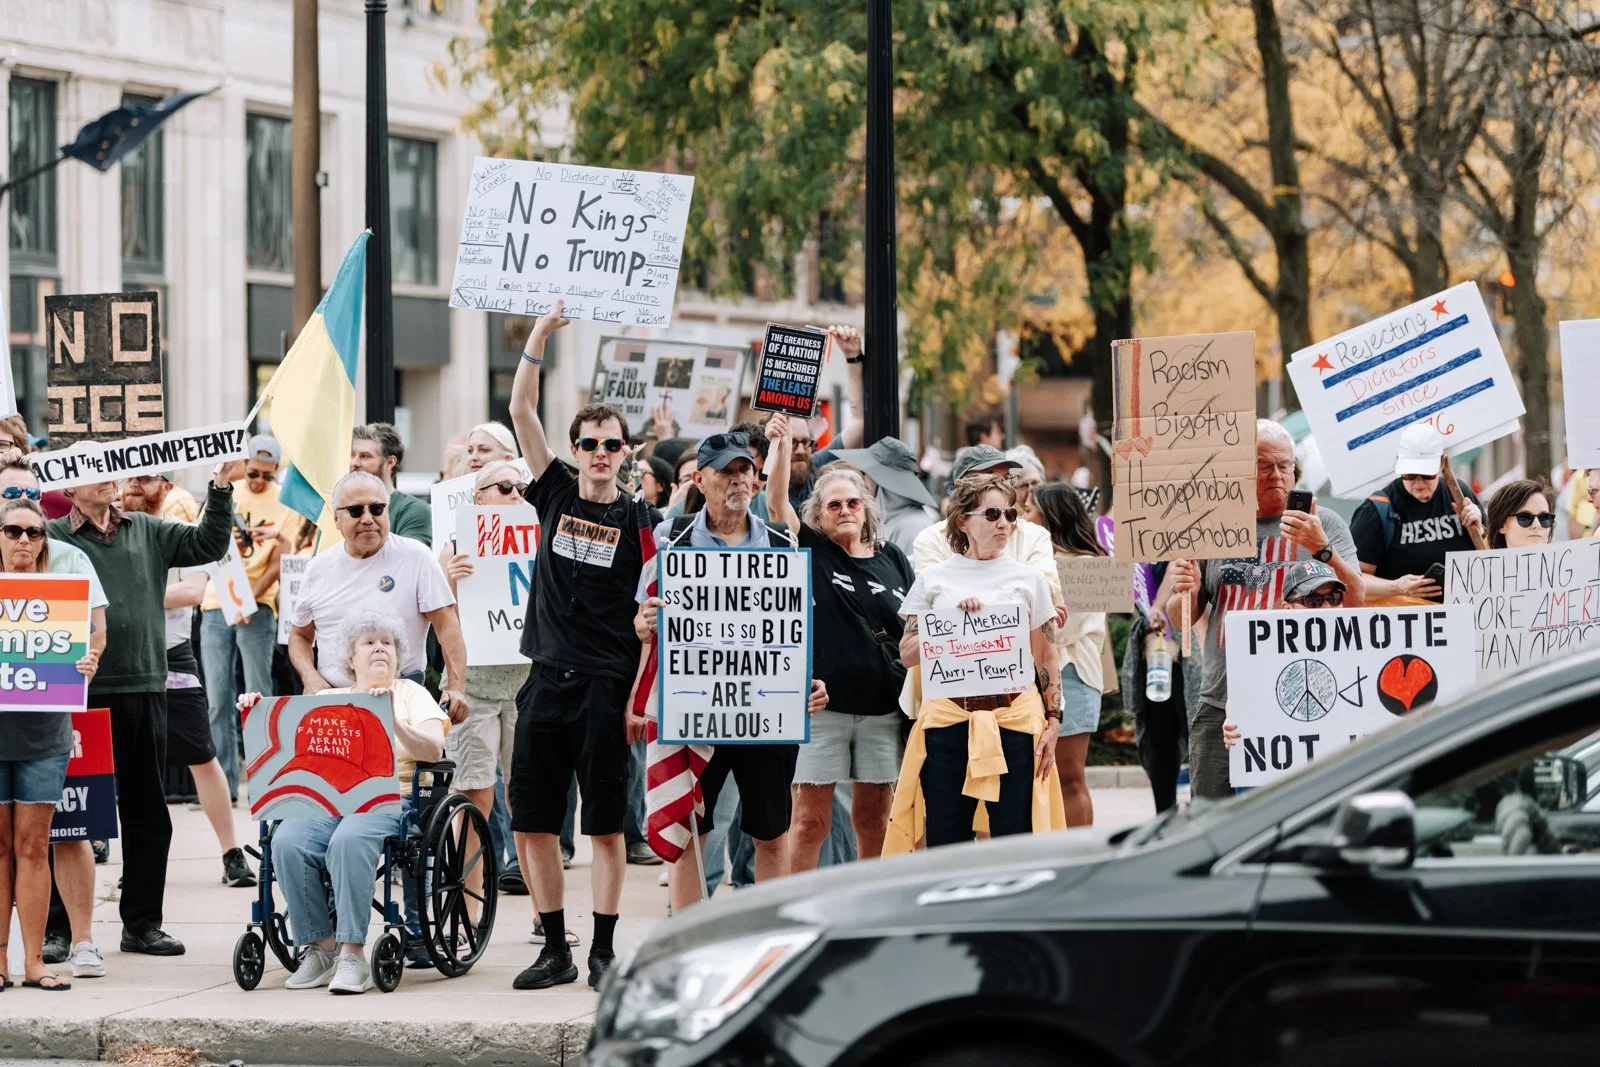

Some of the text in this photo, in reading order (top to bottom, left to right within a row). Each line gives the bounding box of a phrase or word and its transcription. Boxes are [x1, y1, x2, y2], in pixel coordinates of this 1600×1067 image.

[535, 166, 609, 184] No Dictators
[612, 181, 640, 193] NAZIS
[469, 205, 486, 217] No
[507, 182, 657, 242] No Kings
[502, 232, 646, 286] No Trump
[647, 268, 669, 279] Plan
[459, 274, 487, 287] Send
[499, 278, 522, 289] Felon
[527, 281, 541, 289] 47
[568, 285, 609, 297] Alligator
[612, 289, 660, 304] Alcatraz
[474, 295, 516, 310] Worst
[525, 299, 586, 316] Present
[593, 306, 626, 319] Ever
[54, 302, 152, 364] NO
[771, 333, 822, 349] THE GREATNESS
[1335, 313, 1427, 369] Rejecting
[768, 342, 820, 360] OF A NATION
[765, 358, 817, 375] IS MEASURED
[772, 370, 787, 379] HOW
[787, 372, 793, 380] IT
[793, 373, 815, 383] TREATS
[1150, 350, 1230, 384] Racism
[1346, 347, 1436, 403] Dictators
[607, 380, 648, 399] FAUX
[759, 390, 811, 410] AMONG US
[762, 377, 813, 397] THE LEAST
[47, 383, 164, 432] ICE
[1152, 401, 1240, 446] Bigotry
[78, 454, 104, 473] THE
[104, 430, 245, 473] INCOMPETENT!
[1129, 459, 1245, 515] Homophobia
[1121, 517, 1252, 558] Transphobia
[1400, 514, 1463, 545] RESIST
[666, 552, 789, 579] OLD TIRED
[1451, 549, 1573, 594] NOTHING
[0, 597, 49, 623] ve
[721, 623, 735, 638] IS
[741, 624, 756, 639] SO
[762, 619, 803, 645] BIG
[1248, 611, 1448, 656] PROMOTE
[923, 635, 1015, 659] PRO IMMIGRANT
[930, 648, 1024, 681] ANTI-TRUMP!
[711, 681, 752, 707] ARE
[297, 726, 361, 738] FASCISTS
[309, 717, 347, 729] MAKE
[307, 745, 350, 759] AGAIN!
[309, 737, 351, 747] AFRAID
[1243, 734, 1320, 773] NOT
[418, 787, 432, 798] drive
[49, 827, 88, 838] HOICE
